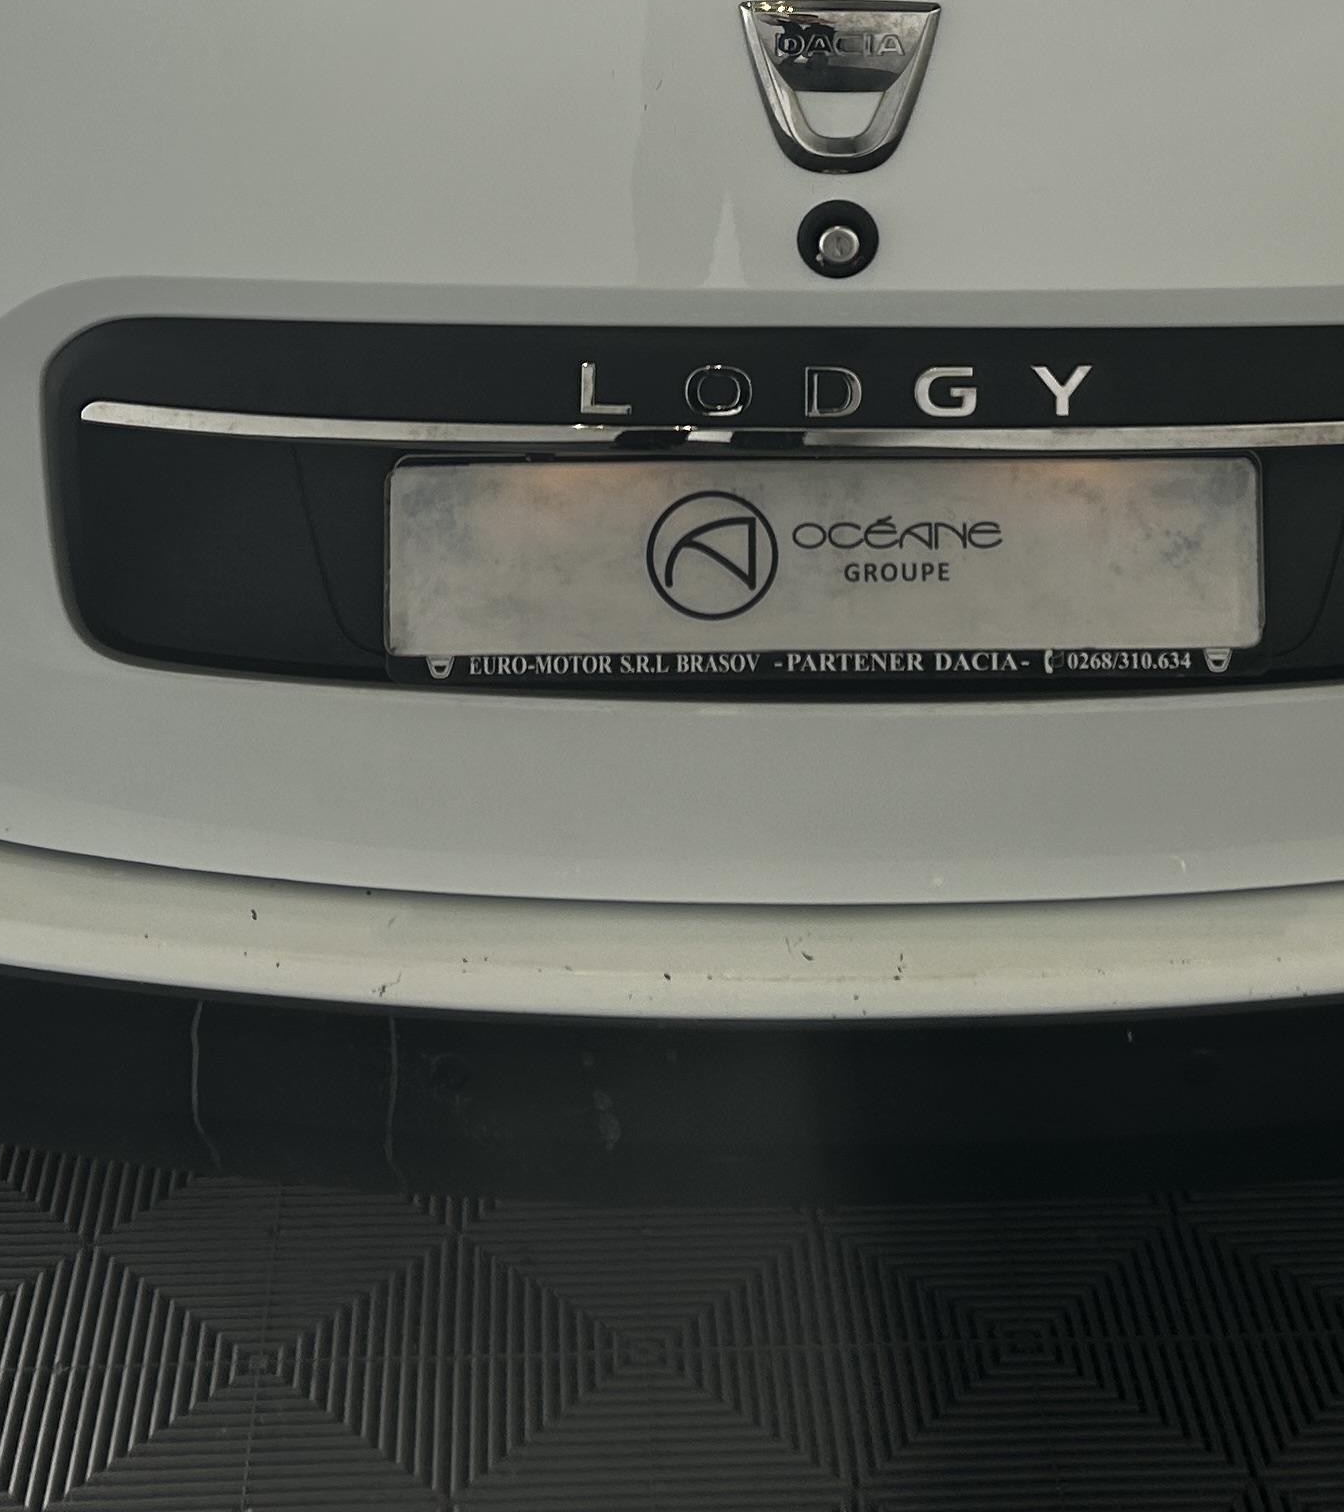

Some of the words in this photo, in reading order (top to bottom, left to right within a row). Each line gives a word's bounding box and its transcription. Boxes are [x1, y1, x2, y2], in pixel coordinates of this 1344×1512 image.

[775, 32, 906, 57] DACIA
[580, 362, 1093, 418] LODGY
[792, 515, 1003, 550] OCÉANE
[844, 562, 950, 583] GROUPE
[469, 654, 612, 675] EURO-MOTOR
[620, 653, 669, 674] S.R.L
[676, 652, 760, 674] BRASOV
[1067, 651, 1192, 671] 0268/310.634
